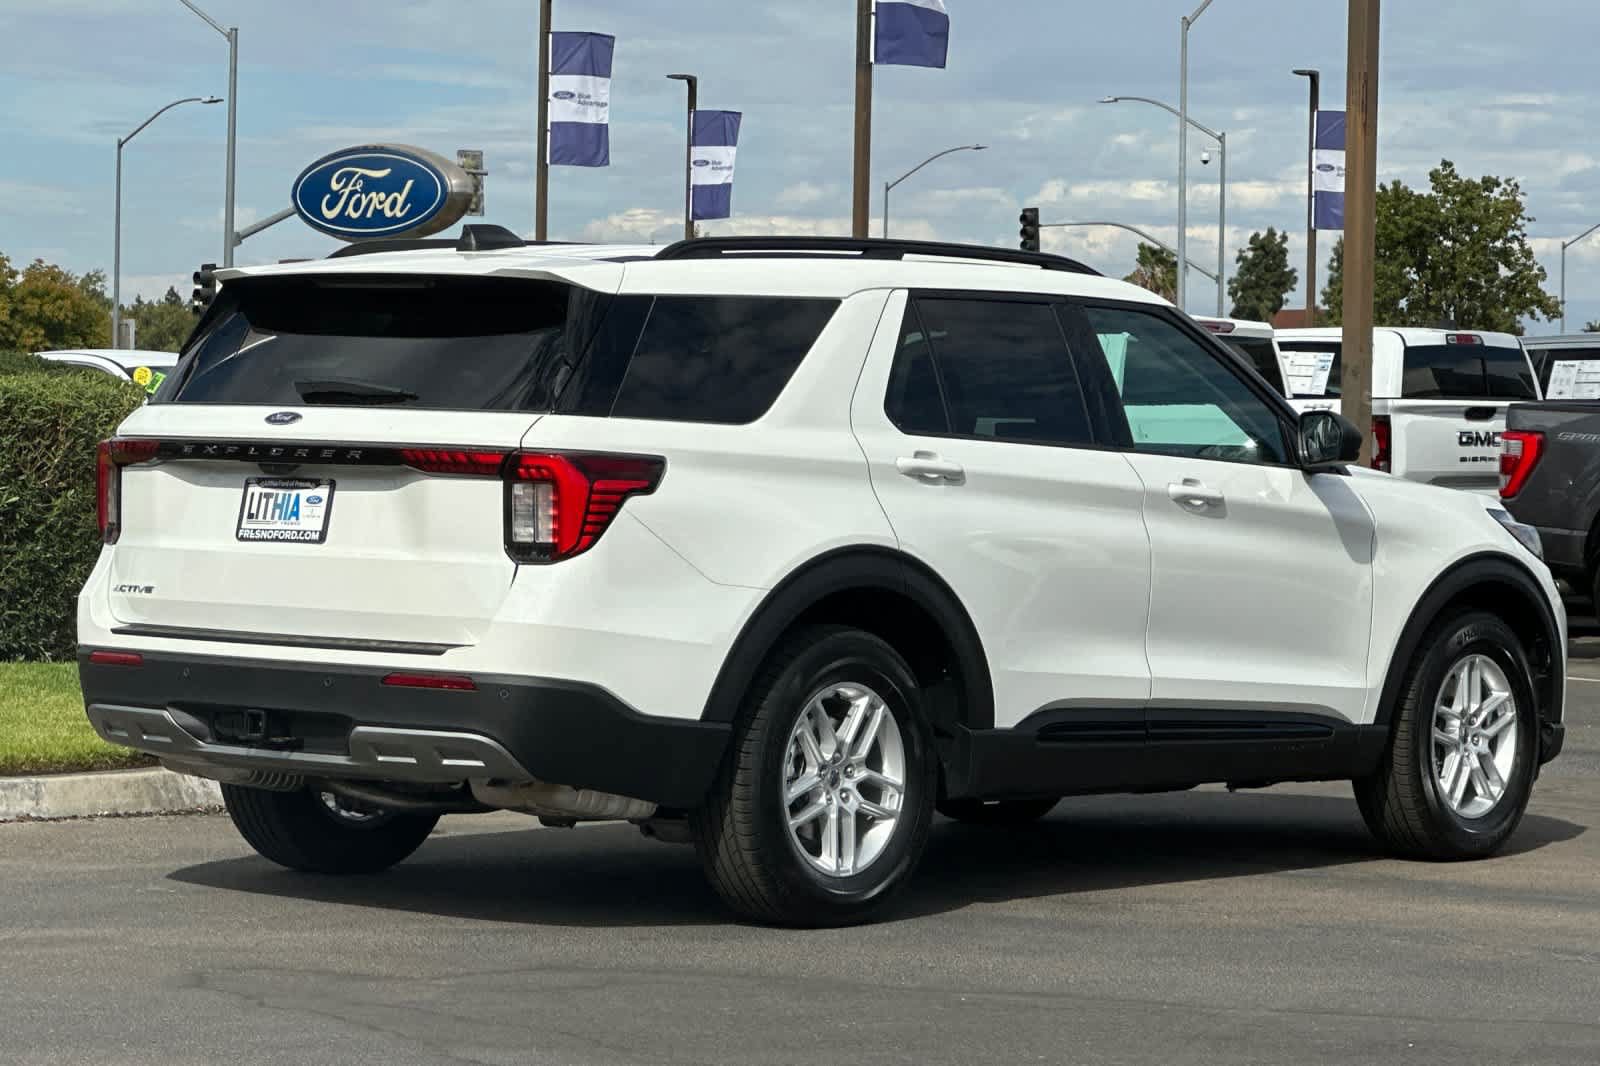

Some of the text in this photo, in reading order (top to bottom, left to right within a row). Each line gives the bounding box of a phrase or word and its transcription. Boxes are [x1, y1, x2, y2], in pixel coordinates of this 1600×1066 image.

[321, 167, 414, 219] Ford
[1458, 431, 1503, 447] GMC
[183, 445, 362, 460] EXPLORER
[247, 492, 300, 520] LITHIA
[239, 528, 320, 540] FRESNOFORD.COM
[112, 584, 155, 594] ACTIVE
